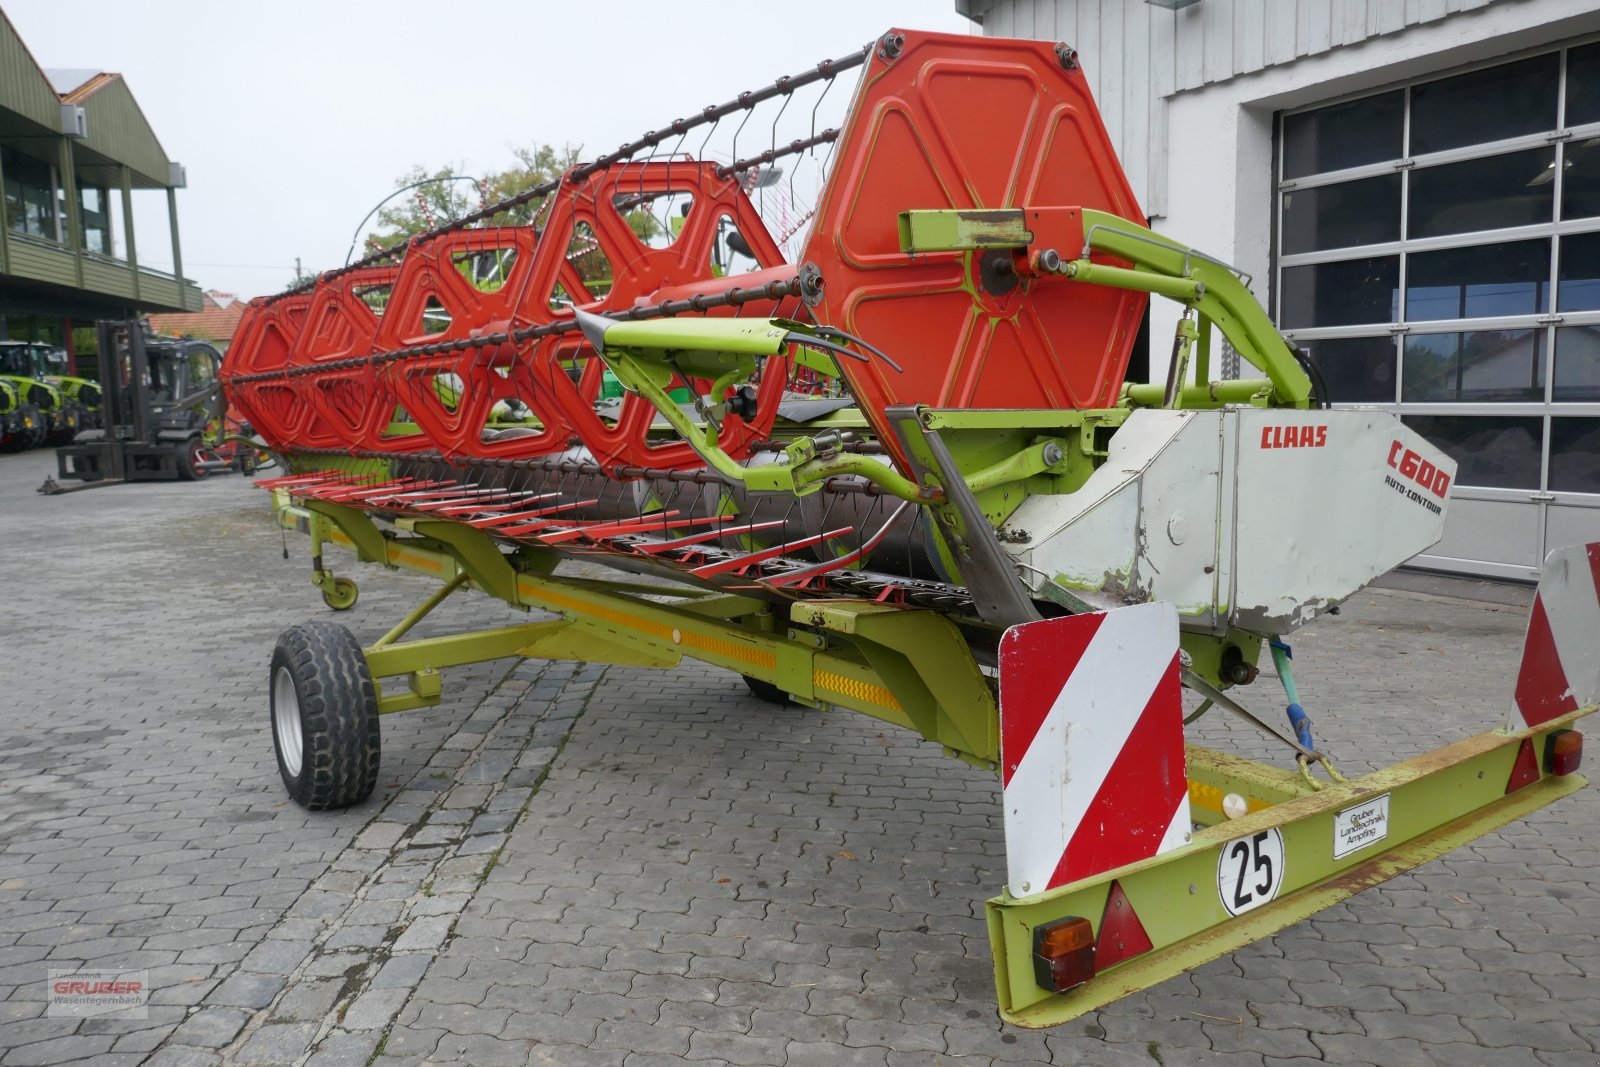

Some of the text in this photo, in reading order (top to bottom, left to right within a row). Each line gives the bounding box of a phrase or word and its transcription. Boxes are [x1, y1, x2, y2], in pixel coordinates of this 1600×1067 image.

[1260, 425, 1328, 449] CLAAS
[1384, 474, 1442, 516] AUTO-CONTOUR
[1350, 808, 1375, 823] Gruber
[1346, 827, 1376, 846] Ampfing
[1231, 830, 1273, 909] 25
